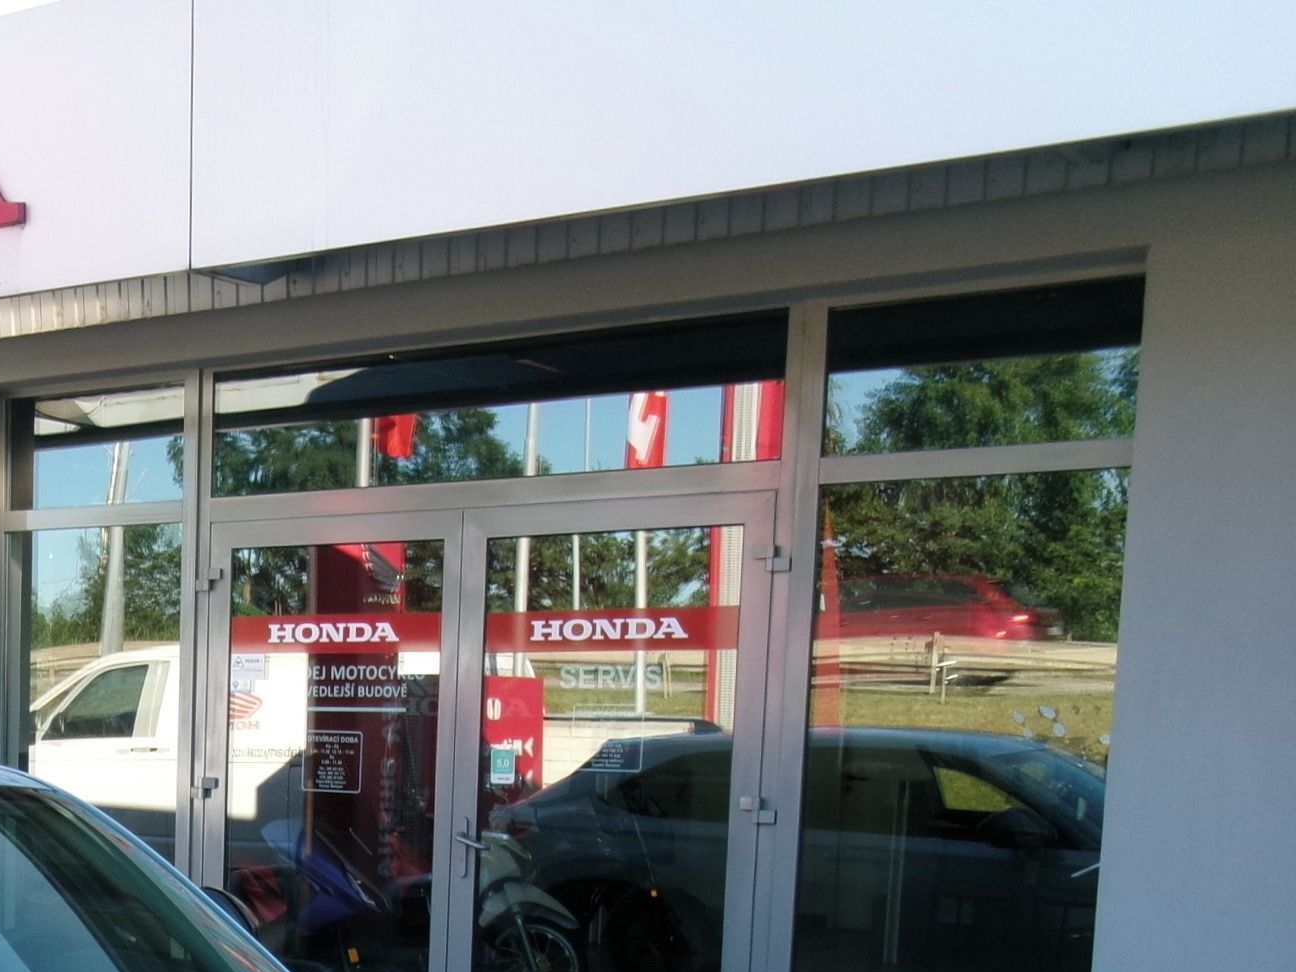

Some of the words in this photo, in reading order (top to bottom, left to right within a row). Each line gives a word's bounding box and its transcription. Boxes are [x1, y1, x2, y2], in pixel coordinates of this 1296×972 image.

[268, 622, 399, 643] HONDA
[530, 617, 688, 641] HONDA
[559, 664, 664, 689] SERVS
[358, 683, 408, 698] BUDOVĚ
